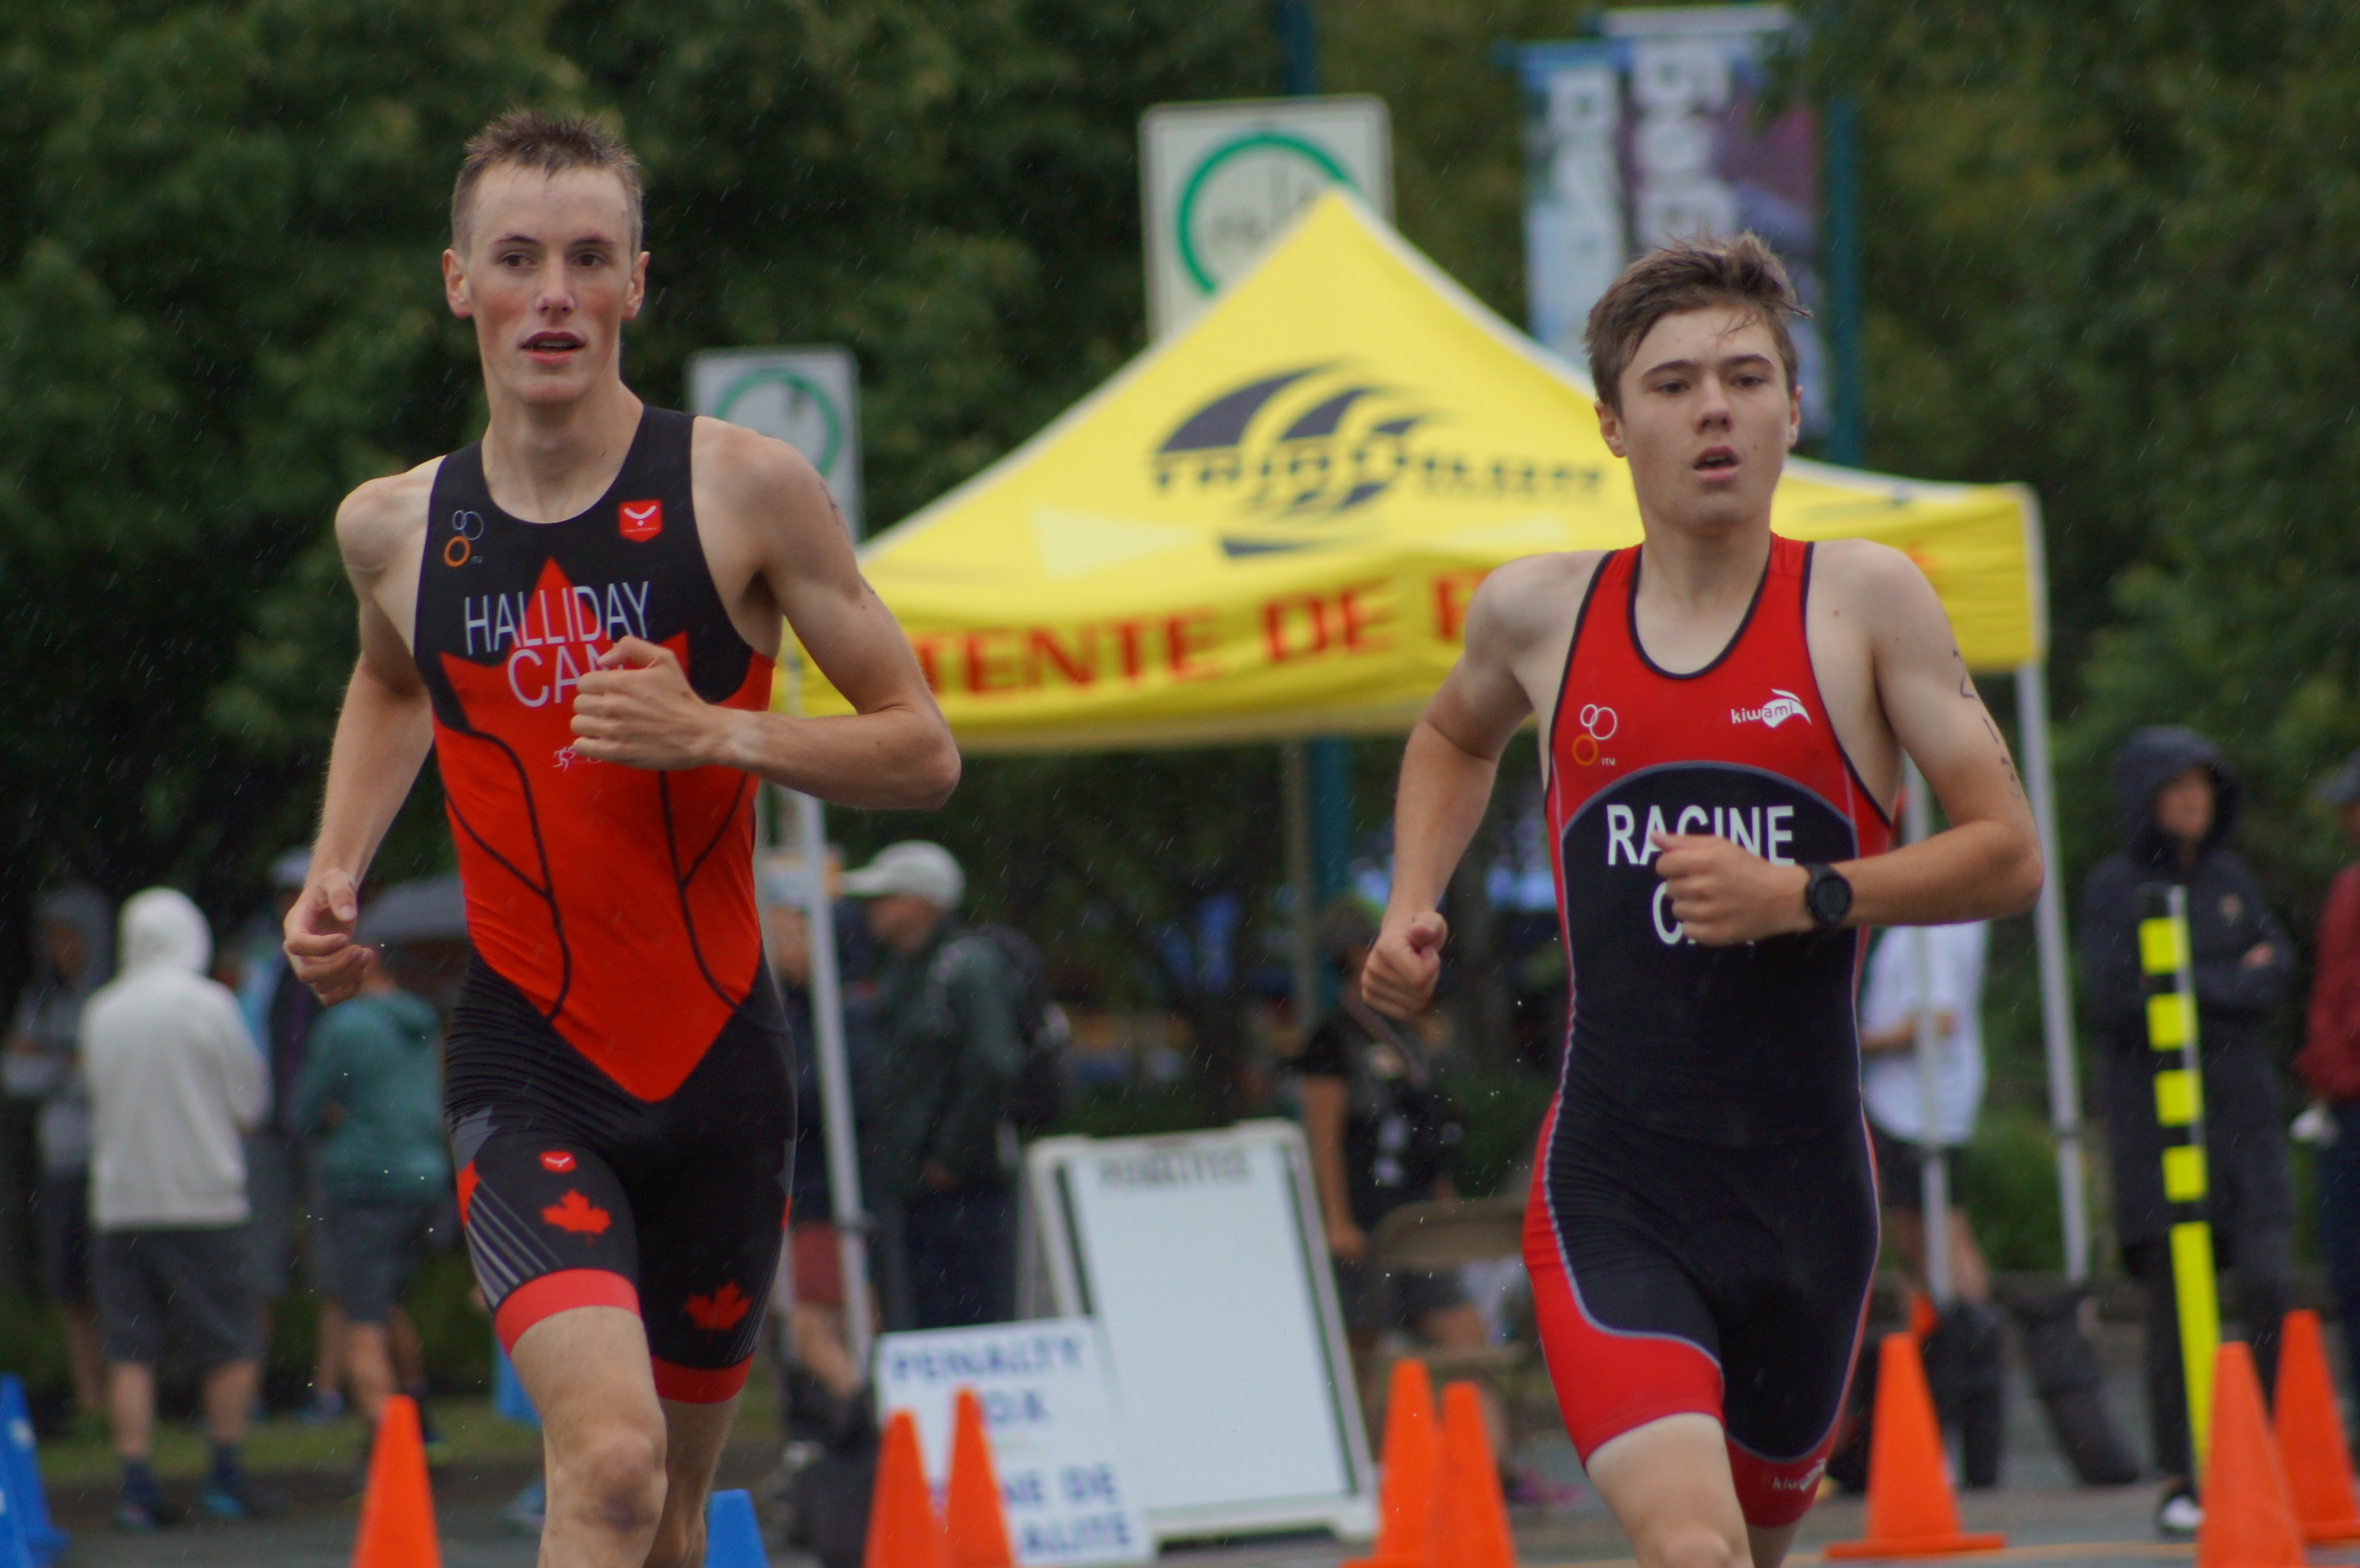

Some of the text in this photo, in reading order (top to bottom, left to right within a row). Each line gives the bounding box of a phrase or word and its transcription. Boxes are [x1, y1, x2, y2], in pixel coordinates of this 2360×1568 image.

[465, 581, 649, 656] HALLIDAY
[1262, 576, 1387, 662] DE
[1731, 701, 1794, 724] kiwami
[1601, 757, 1616, 766] ITU
[895, 1337, 1080, 1378] PENALTY
[981, 1388, 1053, 1425] OX
